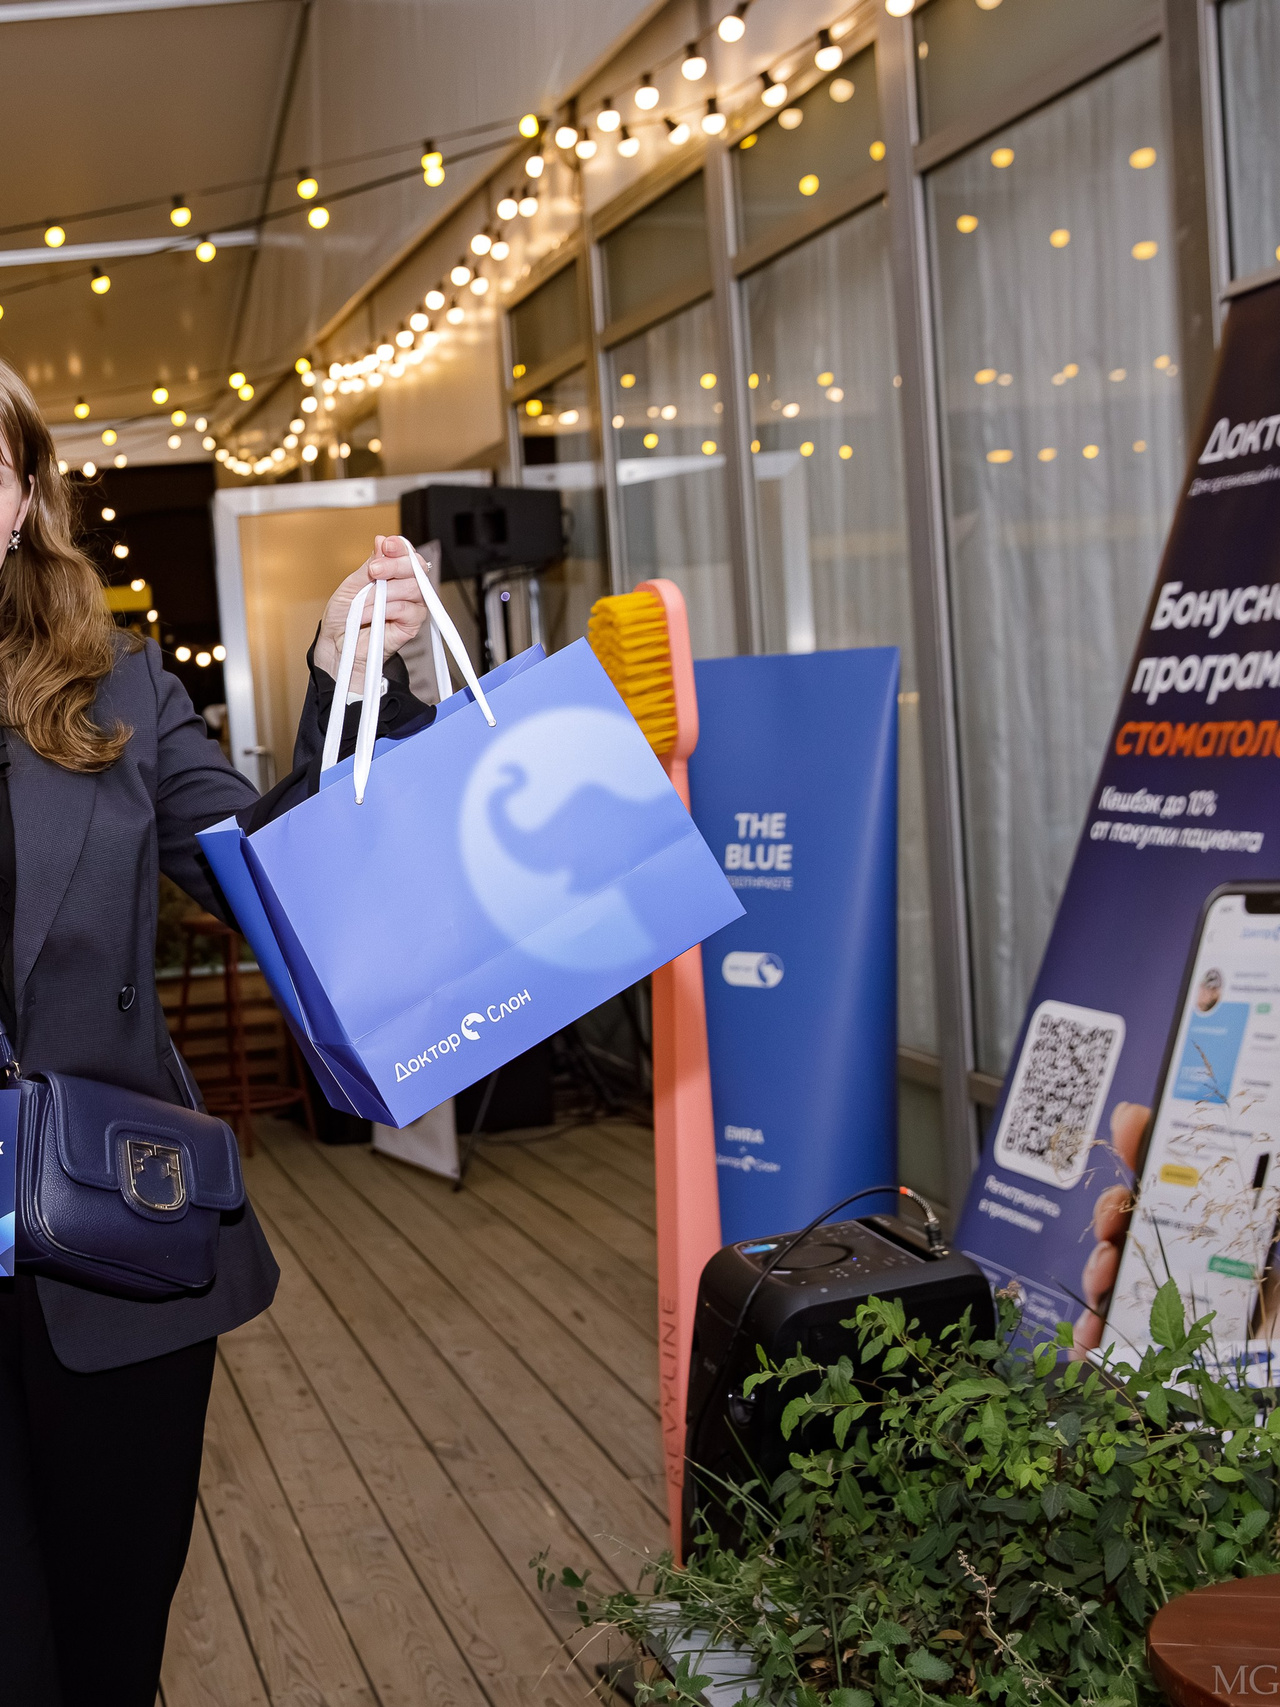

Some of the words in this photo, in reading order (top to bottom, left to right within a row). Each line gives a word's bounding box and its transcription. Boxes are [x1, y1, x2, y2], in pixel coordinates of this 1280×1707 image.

[1198, 414, 1280, 465] Докт
[1150, 581, 1280, 639] Бонусн
[1115, 720, 1280, 758] стоматол
[1160, 795, 1187, 819] до
[734, 812, 787, 839] THE
[1090, 820, 1112, 841] от
[724, 843, 793, 871] BLUE
[393, 1033, 461, 1083] Доктор
[486, 988, 532, 1023] Слон
